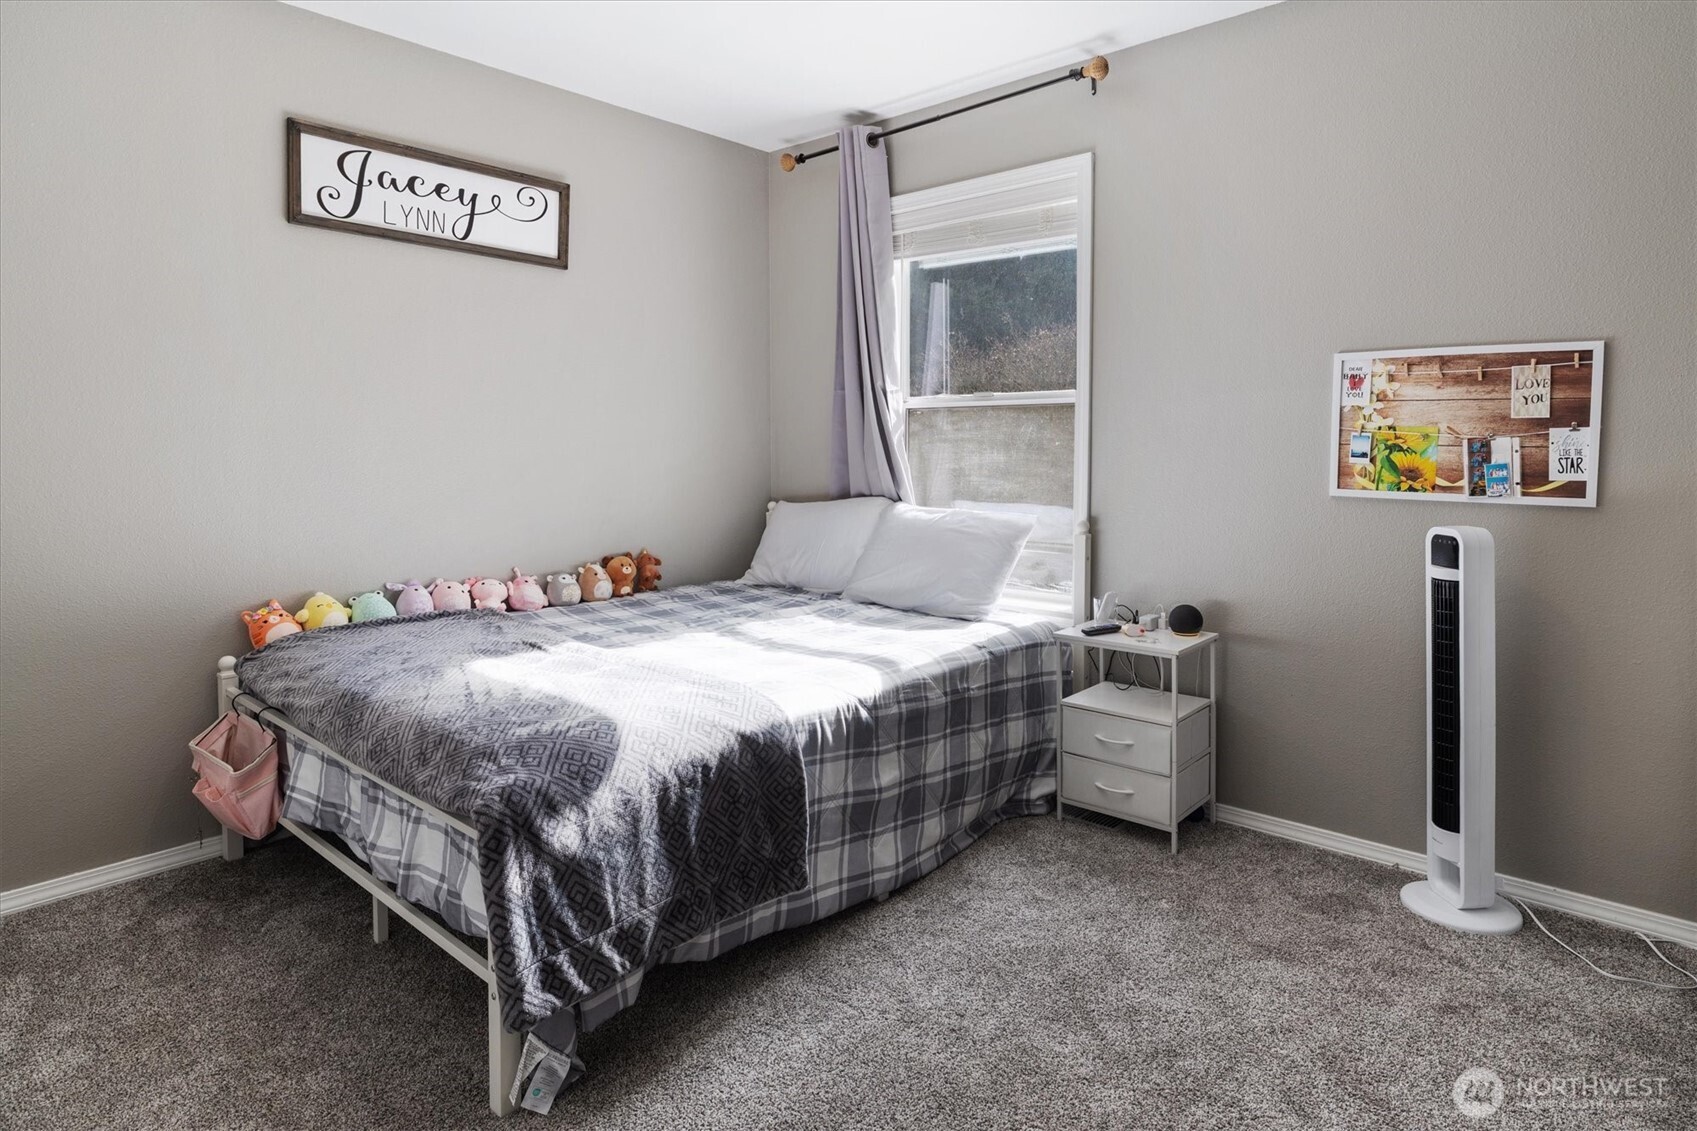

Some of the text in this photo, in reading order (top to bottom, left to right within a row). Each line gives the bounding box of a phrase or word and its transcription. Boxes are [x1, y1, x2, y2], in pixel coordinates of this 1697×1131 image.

[316, 149, 548, 241] Jacey
[383, 200, 446, 234] LYNN
[1515, 378, 1550, 391] LOVE
[1522, 393, 1548, 406] YOU
[1559, 448, 1584, 457] LIKE THE
